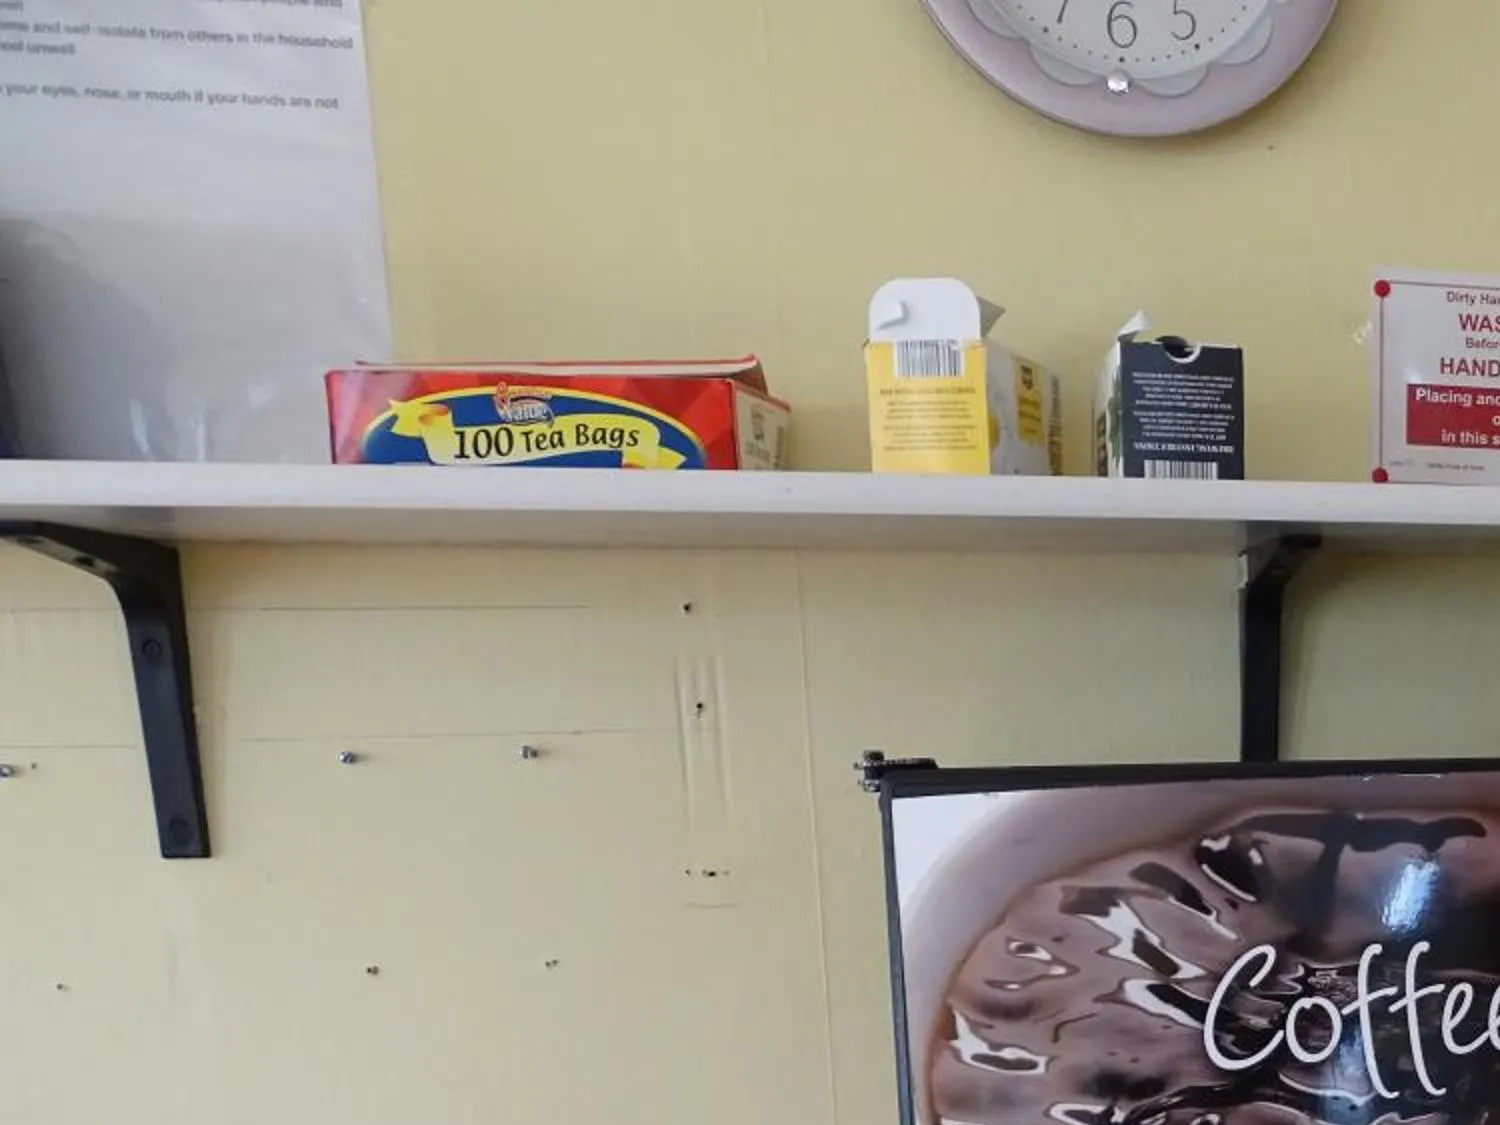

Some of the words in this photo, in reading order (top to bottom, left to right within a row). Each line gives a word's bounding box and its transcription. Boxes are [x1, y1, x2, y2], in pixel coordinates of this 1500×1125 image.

[1107, 0, 1137, 49] 6
[252, 32, 275, 43] the
[278, 33, 353, 48] household
[145, 89, 191, 102] mouth
[207, 92, 238, 106] your
[242, 93, 287, 106] hands
[290, 96, 311, 107] are
[315, 96, 339, 109] not
[1446, 290, 1476, 306] Dirty
[1415, 388, 1472, 407] Placing
[454, 426, 514, 459] 100
[522, 426, 565, 452] Tea
[576, 423, 640, 450] Bags
[1441, 429, 1455, 443] in
[1460, 430, 1488, 446] this
